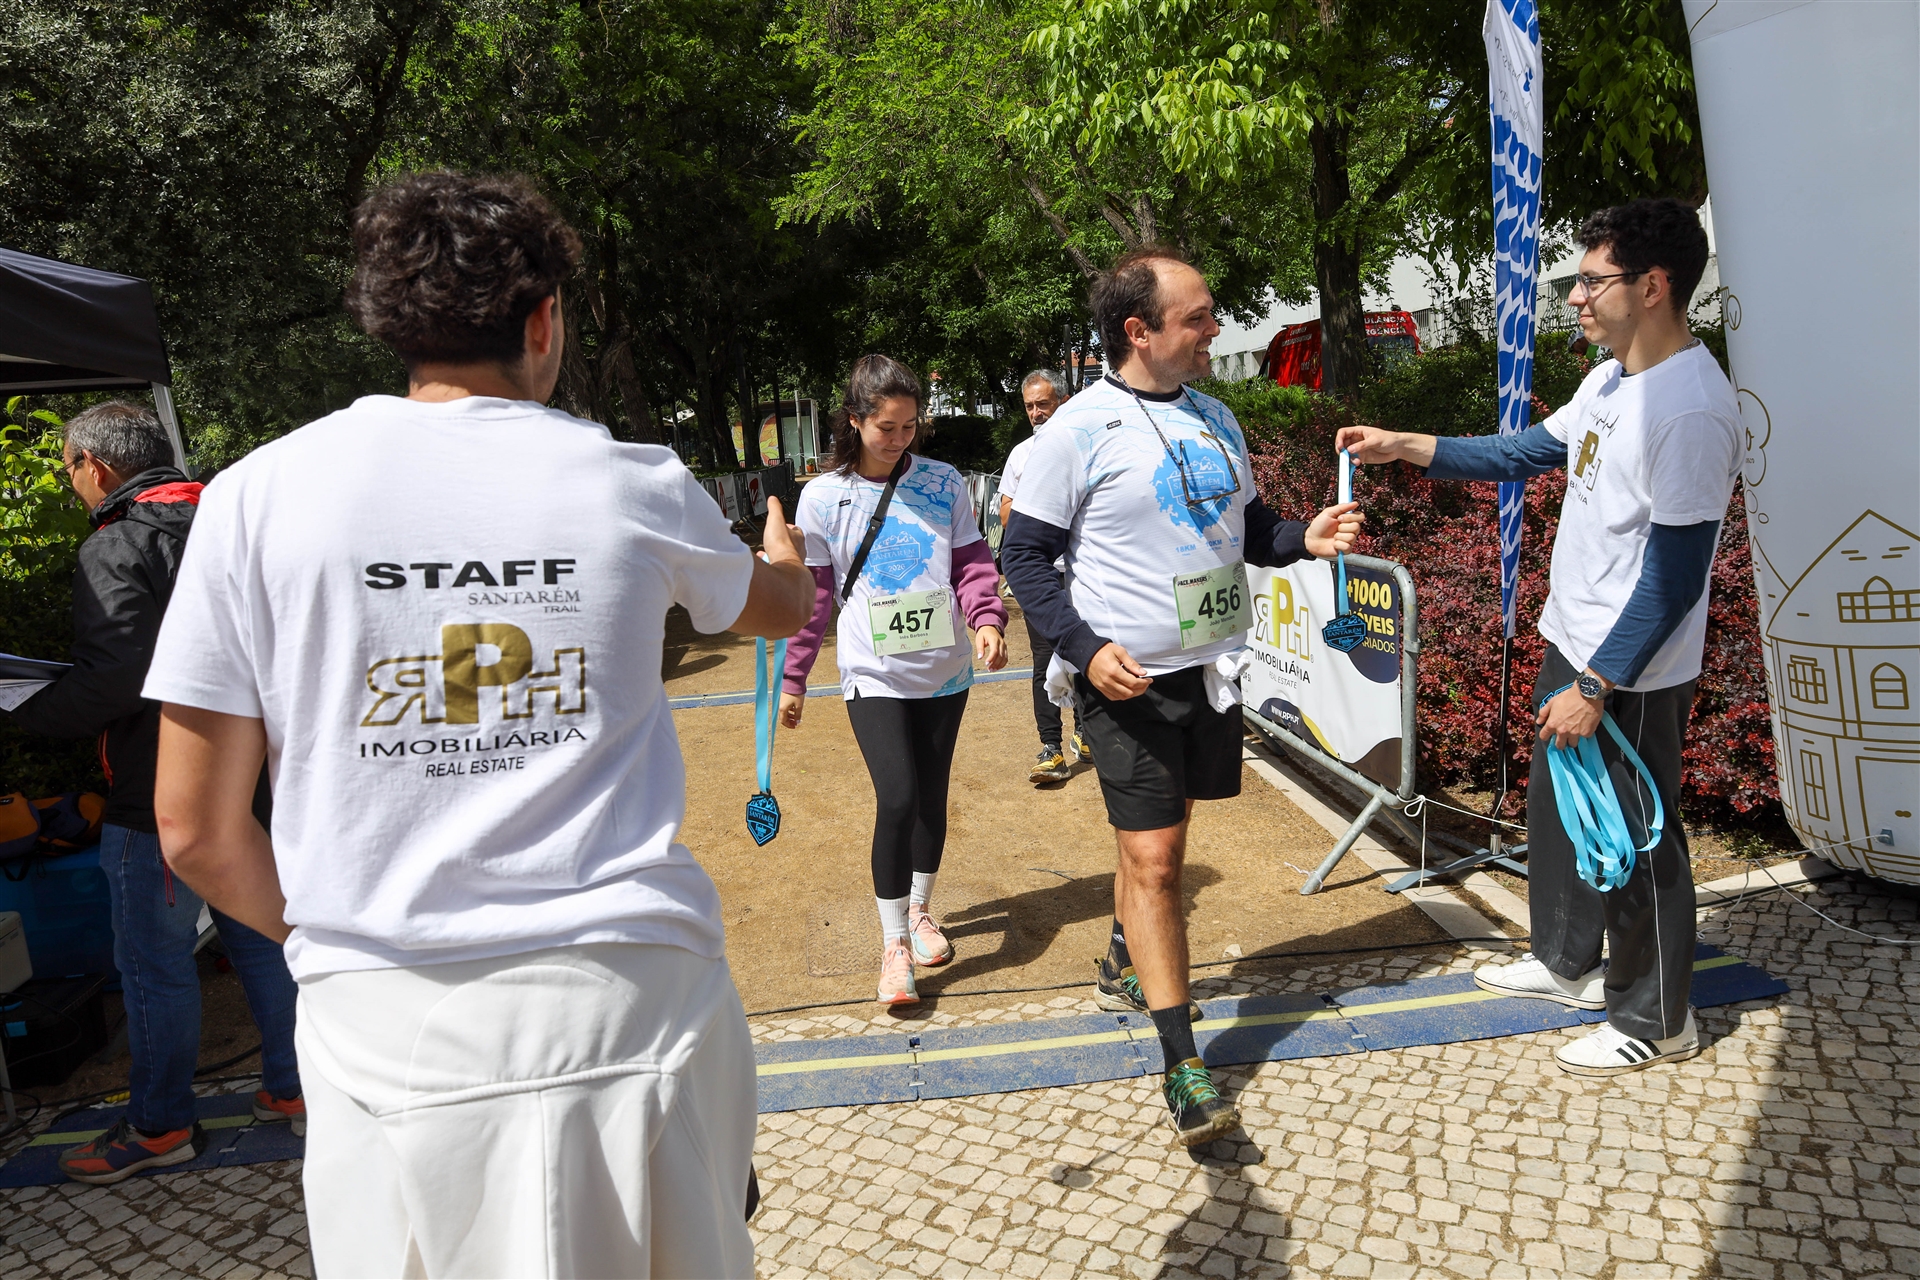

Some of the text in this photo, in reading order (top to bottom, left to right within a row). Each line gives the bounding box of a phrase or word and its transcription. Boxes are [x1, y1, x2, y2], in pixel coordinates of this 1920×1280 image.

[1364, 316, 1406, 324] ULÂNCIA
[1365, 327, 1406, 335] RGÊNCIA
[364, 559, 576, 589] STAFF
[468, 587, 581, 605] SANTARÉM
[1198, 584, 1241, 619] 456
[1346, 578, 1392, 609] +1000
[543, 605, 581, 613] TRAIL
[889, 608, 934, 634] 457
[1362, 636, 1396, 654] RIADOS
[1255, 648, 1311, 684] IMOBILIÁRIA
[1278, 676, 1298, 690] ESTATE
[360, 728, 587, 757] IMOBILIÁRIA
[425, 756, 526, 777] REAL ESTATE
